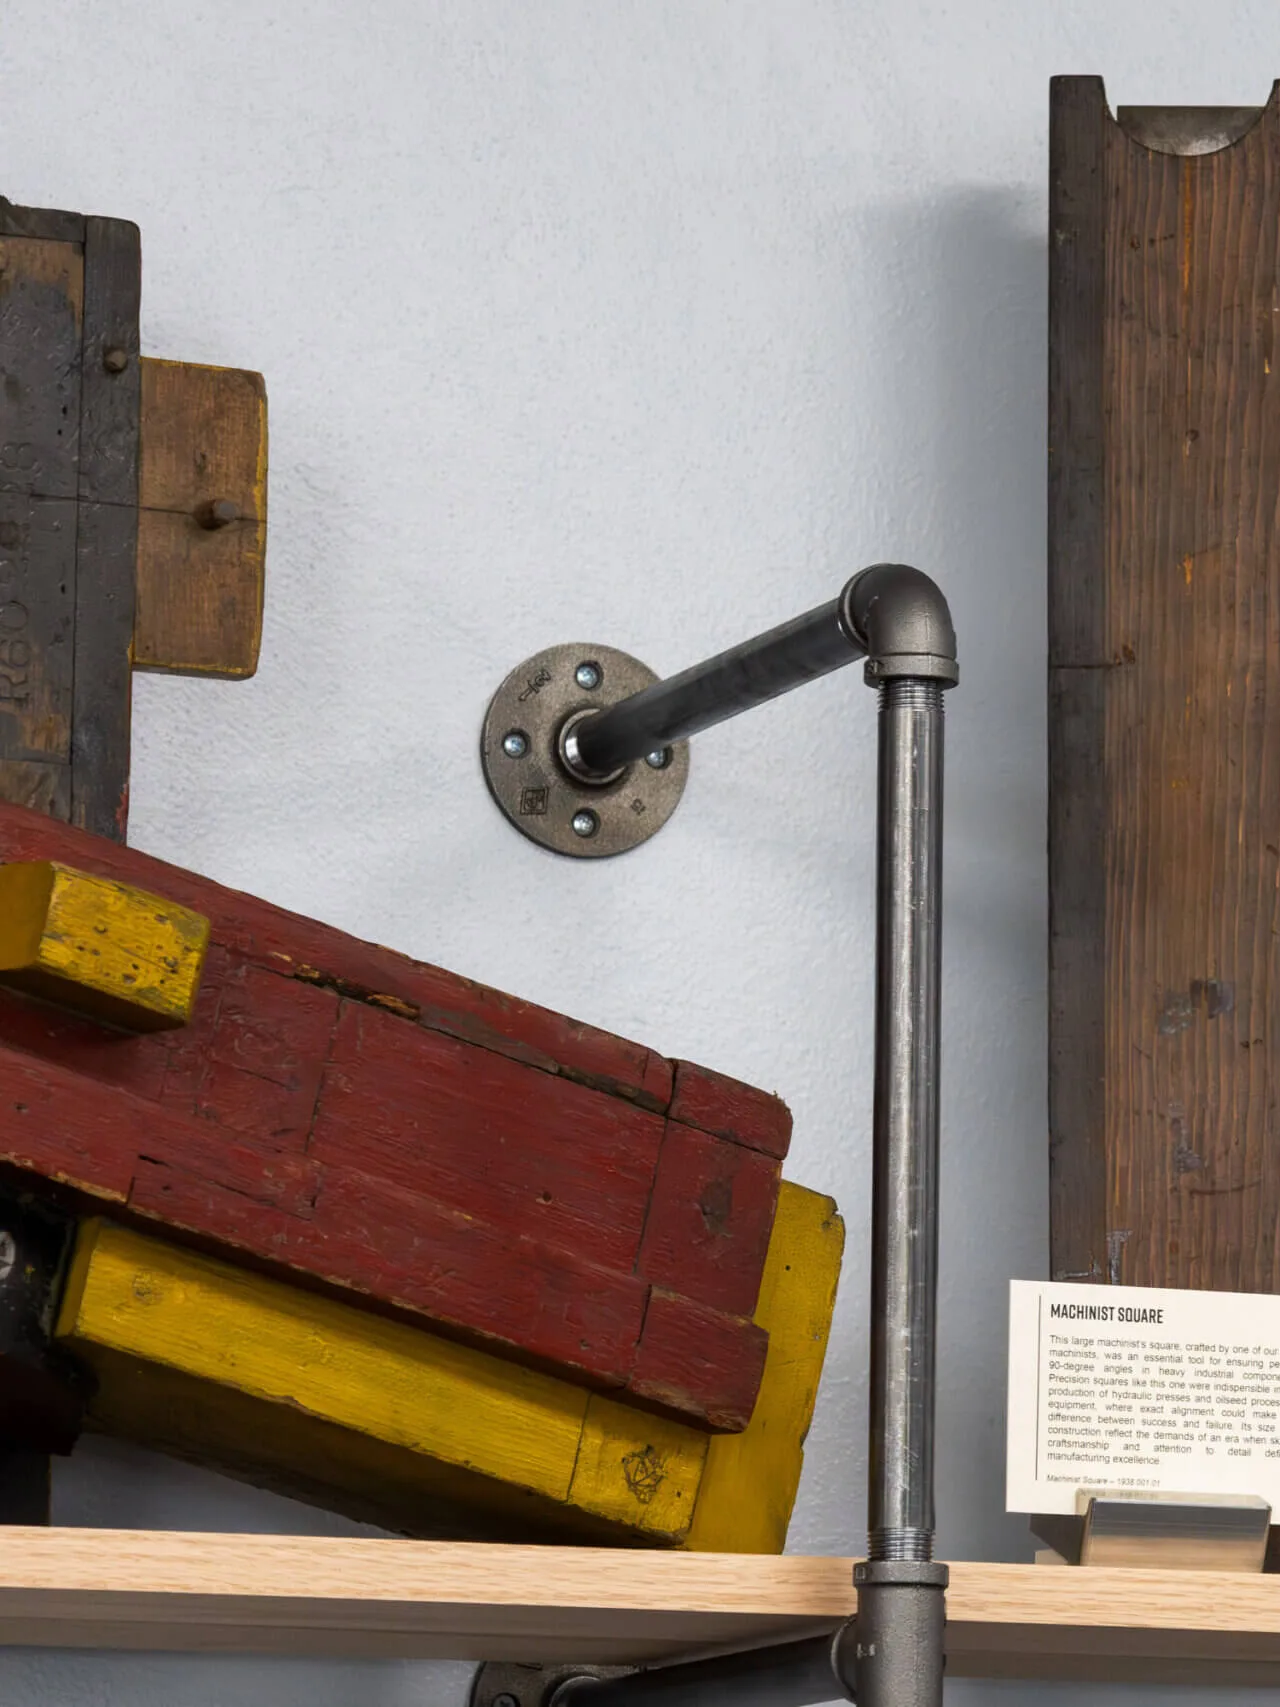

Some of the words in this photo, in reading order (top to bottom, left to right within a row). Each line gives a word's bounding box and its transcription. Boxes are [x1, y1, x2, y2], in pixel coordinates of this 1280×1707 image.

[1051, 1303, 1114, 1321] MACHINIST
[1118, 1307, 1163, 1324] SQUARE
[1050, 1335, 1068, 1345] This
[1072, 1336, 1094, 1348] large
[1186, 1342, 1216, 1352] crafted
[1219, 1344, 1229, 1355] by
[1233, 1346, 1249, 1354] one
[1252, 1346, 1261, 1355] of
[1264, 1348, 1278, 1356] our
[1049, 1360, 1095, 1373] 90-degree
[1104, 1363, 1133, 1375] angles
[1142, 1365, 1150, 1374] in
[1159, 1366, 1185, 1378] heavy
[1194, 1368, 1234, 1379] industrial
[1104, 1352, 1122, 1360] was
[1128, 1353, 1138, 1361] an
[1144, 1353, 1183, 1363] essential
[1188, 1355, 1204, 1365] tool
[1210, 1356, 1221, 1365] for
[1226, 1357, 1264, 1369] ensuring
[1049, 1373, 1090, 1384] Precision
[1094, 1377, 1128, 1388] squares
[1132, 1378, 1147, 1387] like
[1150, 1379, 1166, 1388] this
[1169, 1381, 1186, 1389] one
[1188, 1382, 1210, 1390] were
[1274, 1385, 1280, 1394] in
[1049, 1386, 1095, 1399] production
[1099, 1389, 1108, 1398] of
[1112, 1390, 1152, 1402] hydraulic
[1156, 1393, 1190, 1404] presses
[1195, 1394, 1211, 1403] and
[1216, 1395, 1247, 1405] oilseed
[1106, 1402, 1133, 1412] where
[1140, 1404, 1164, 1414] exact
[1171, 1405, 1214, 1418] alignment
[1221, 1408, 1245, 1418] could
[1253, 1409, 1277, 1419] make
[1048, 1412, 1092, 1423] difference
[1098, 1415, 1135, 1425] between
[1142, 1418, 1177, 1427] success
[1183, 1419, 1200, 1428] and
[1241, 1422, 1252, 1431] Its
[1258, 1422, 1275, 1432] size
[1048, 1425, 1101, 1436] construction
[1105, 1428, 1132, 1438] reflect
[1136, 1429, 1150, 1439] the
[1154, 1430, 1194, 1441] demands
[1198, 1432, 1206, 1442] of
[1225, 1435, 1239, 1443] era
[1243, 1435, 1266, 1444] when
[1048, 1438, 1109, 1451] craftsmanship
[1123, 1442, 1140, 1451] and
[1154, 1443, 1192, 1454] attention
[1206, 1446, 1214, 1455] to
[1228, 1447, 1251, 1456] detail
[1048, 1451, 1110, 1464] manufacturing
